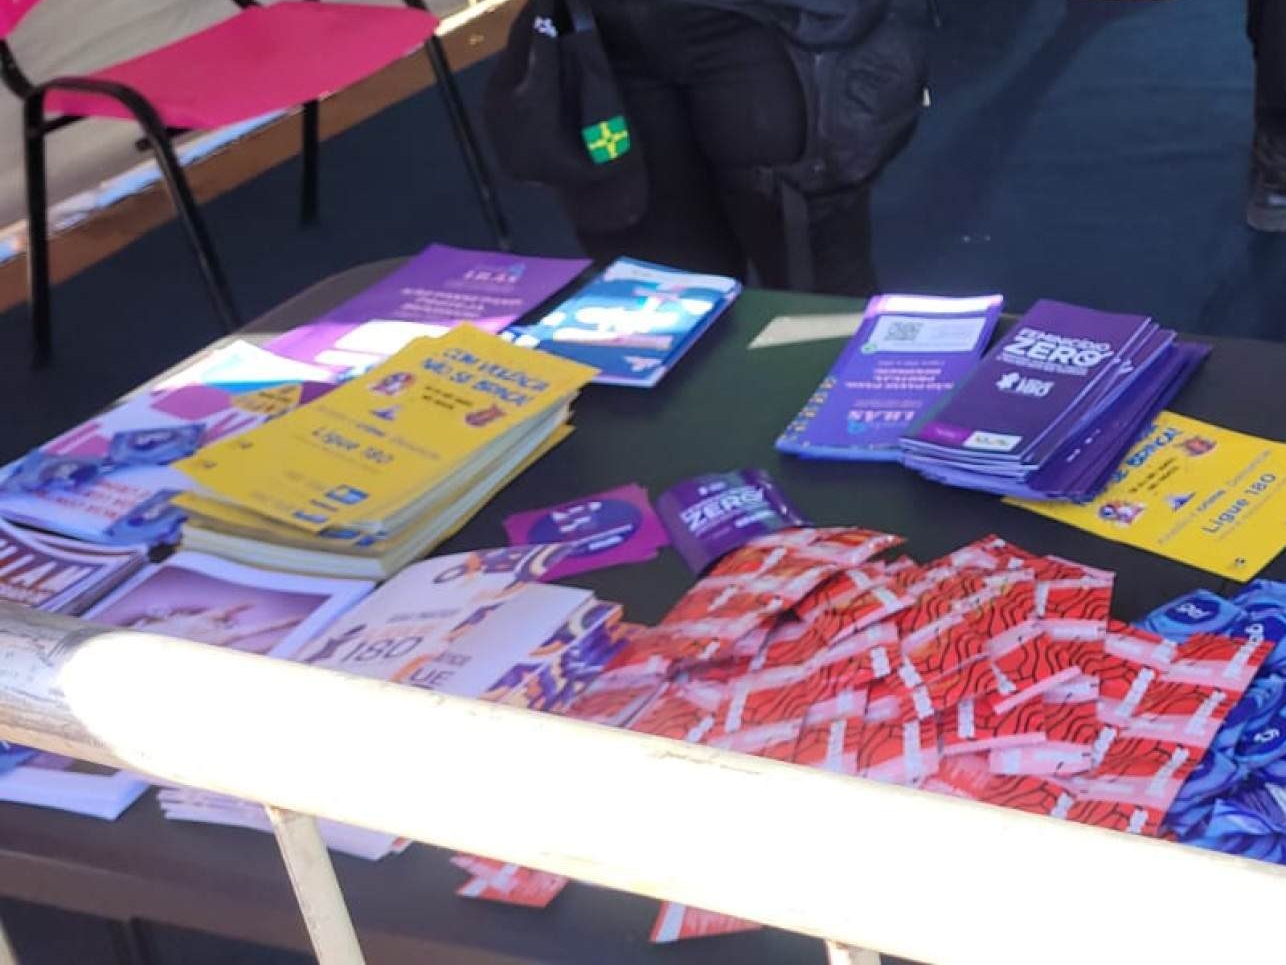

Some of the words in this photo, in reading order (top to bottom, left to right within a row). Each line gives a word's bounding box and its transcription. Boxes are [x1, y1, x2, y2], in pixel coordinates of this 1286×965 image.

[1003, 338, 1104, 367] ZERO
[1202, 497, 1250, 534] Ligue
[1244, 472, 1277, 497] 180
[341, 636, 425, 663] 180
